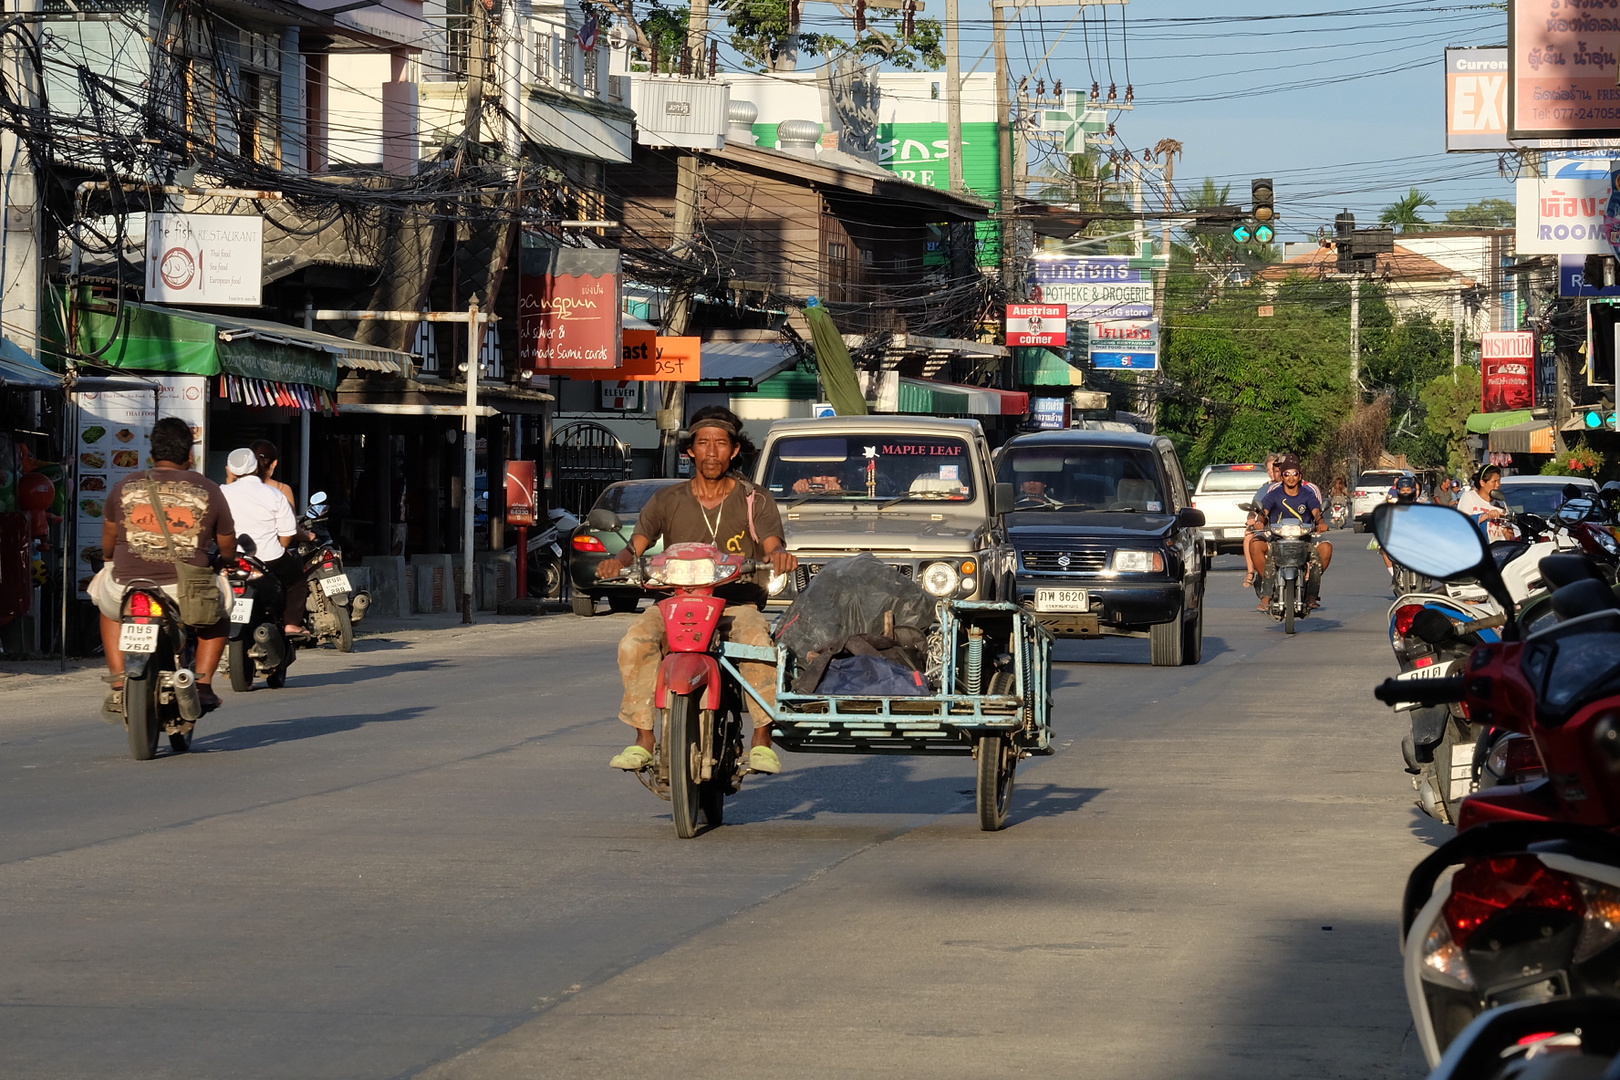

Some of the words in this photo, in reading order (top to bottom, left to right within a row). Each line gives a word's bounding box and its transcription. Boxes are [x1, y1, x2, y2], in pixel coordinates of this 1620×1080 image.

[1573, 41, 1617, 71] น้ำอุ่น
[1453, 76, 1507, 130] EX
[1532, 108, 1551, 120] Tel:
[150, 219, 170, 239] The
[175, 220, 192, 242] fish
[198, 229, 257, 242] RESTAURANT
[210, 249, 220, 258] Thai
[219, 248, 231, 260] food
[209, 262, 217, 270] Sea
[216, 261, 228, 273] food
[209, 275, 230, 286] European
[1092, 287, 1099, 301] &
[1103, 287, 1150, 301] DROGERIE
[1013, 306, 1059, 316] Austrian
[1095, 308, 1122, 317] DRUG
[1125, 308, 1149, 317] store
[533, 320, 556, 339] silver
[1019, 335, 1052, 345] corner
[532, 344, 555, 359] made
[557, 343, 582, 359] Samui
[585, 344, 608, 360] cards
[604, 388, 636, 397] ELEVEN
[882, 445, 926, 455] MAPLE
[929, 446, 962, 456] LEAF
[1059, 591, 1085, 602] 8620
[126, 643, 150, 651] 764
